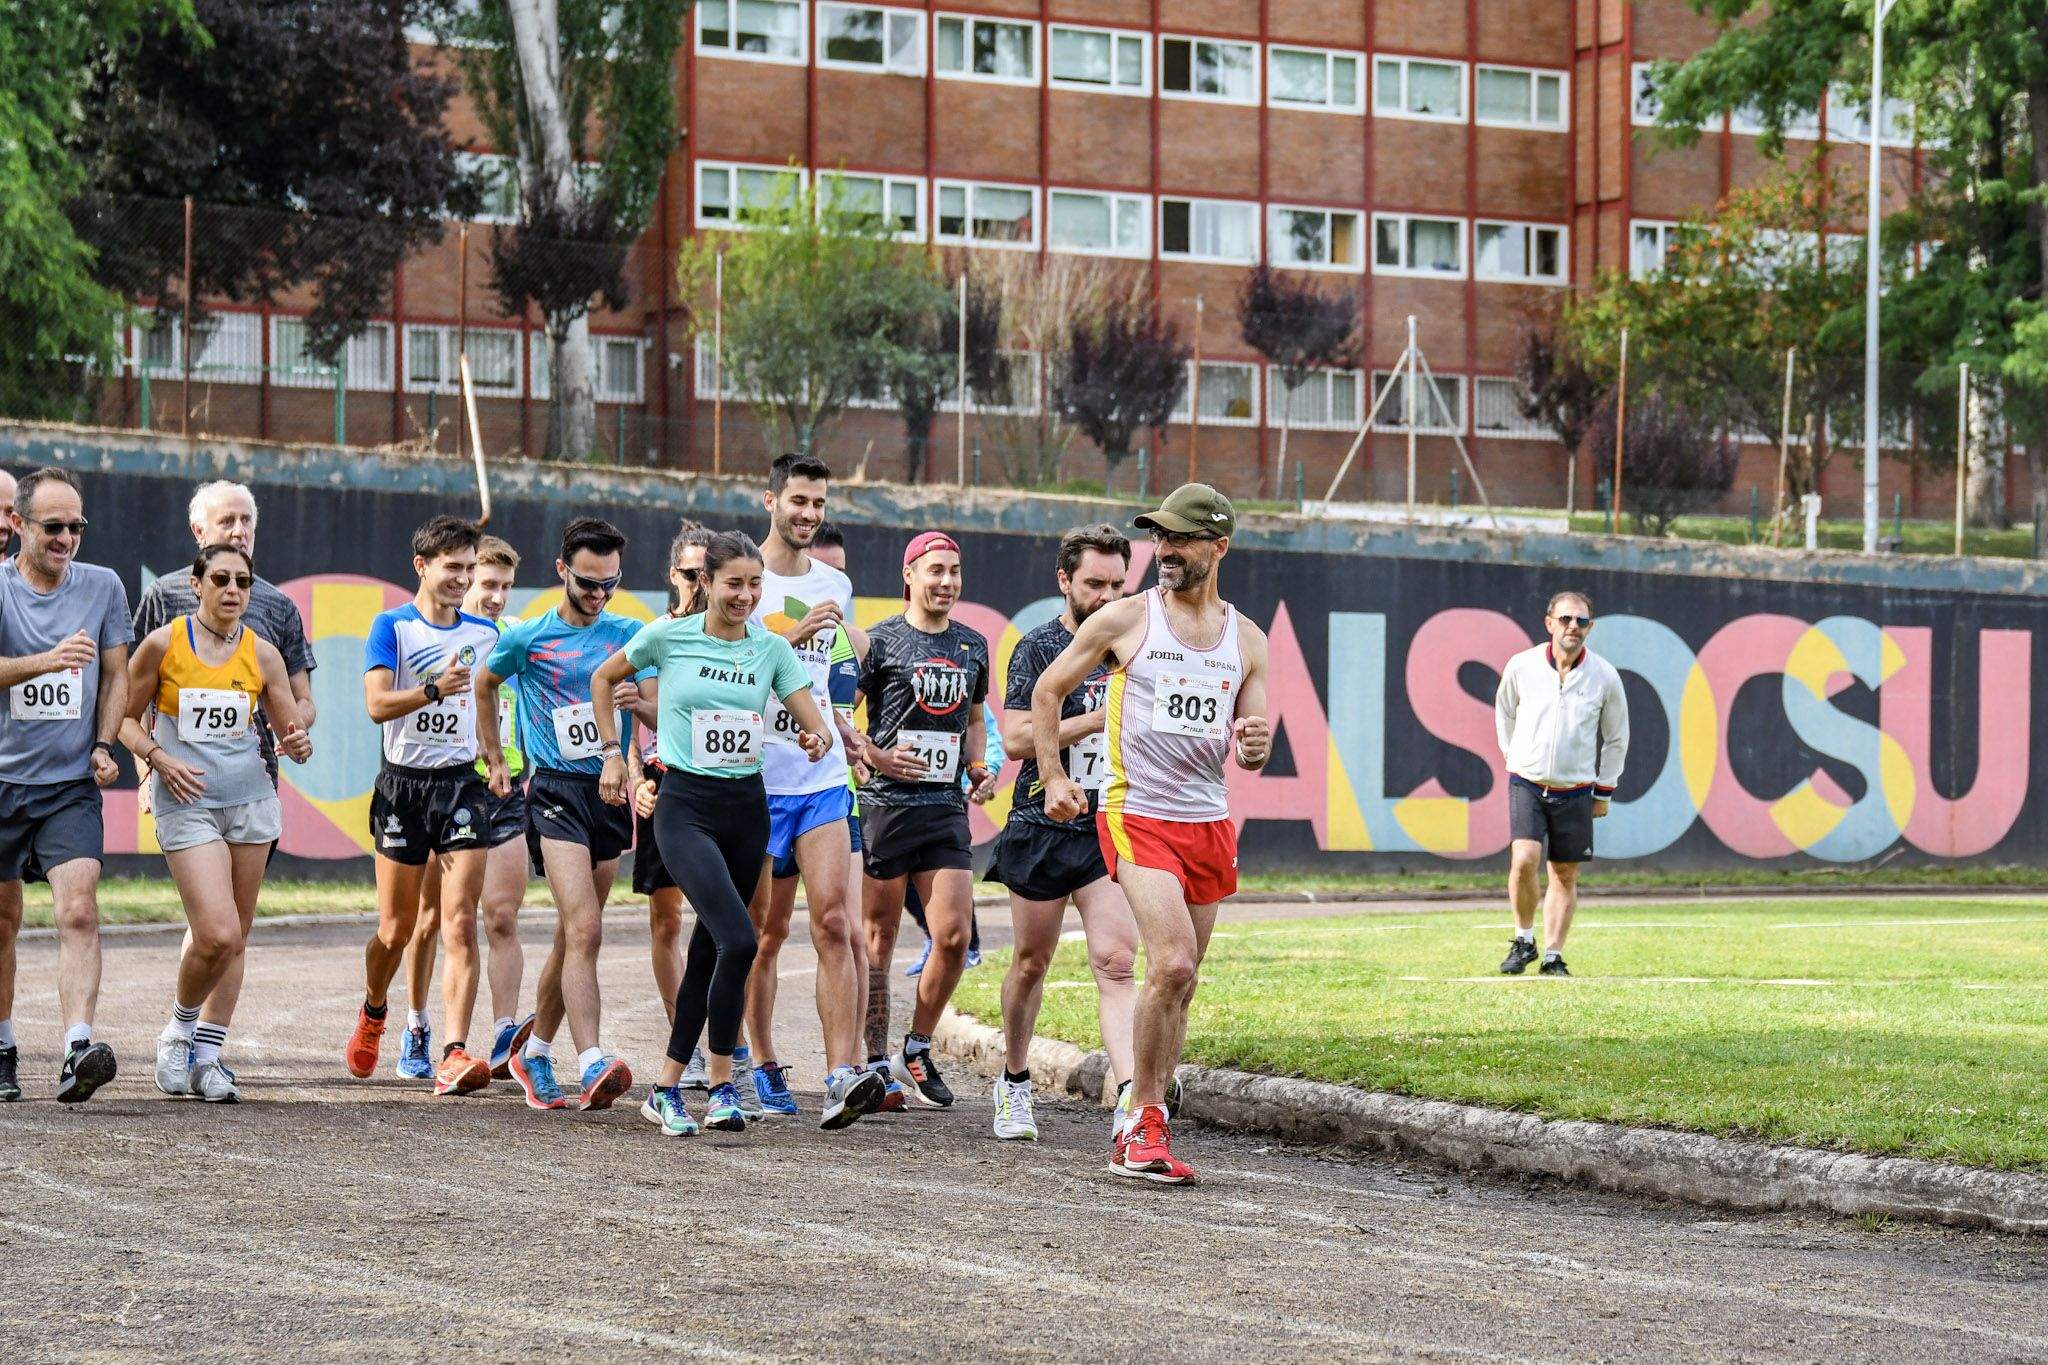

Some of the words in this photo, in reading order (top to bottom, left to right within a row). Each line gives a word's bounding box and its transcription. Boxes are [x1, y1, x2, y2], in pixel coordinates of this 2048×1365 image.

[1146, 650, 1185, 662] Joma
[698, 665, 756, 686] BIKILA
[23, 683, 70, 706] 906
[192, 707, 238, 729] 759
[1167, 693, 1217, 723] 803
[416, 712, 458, 734] 892
[568, 721, 599, 746] 90
[1209, 727, 1222, 735] 2023
[705, 729, 751, 754] 882
